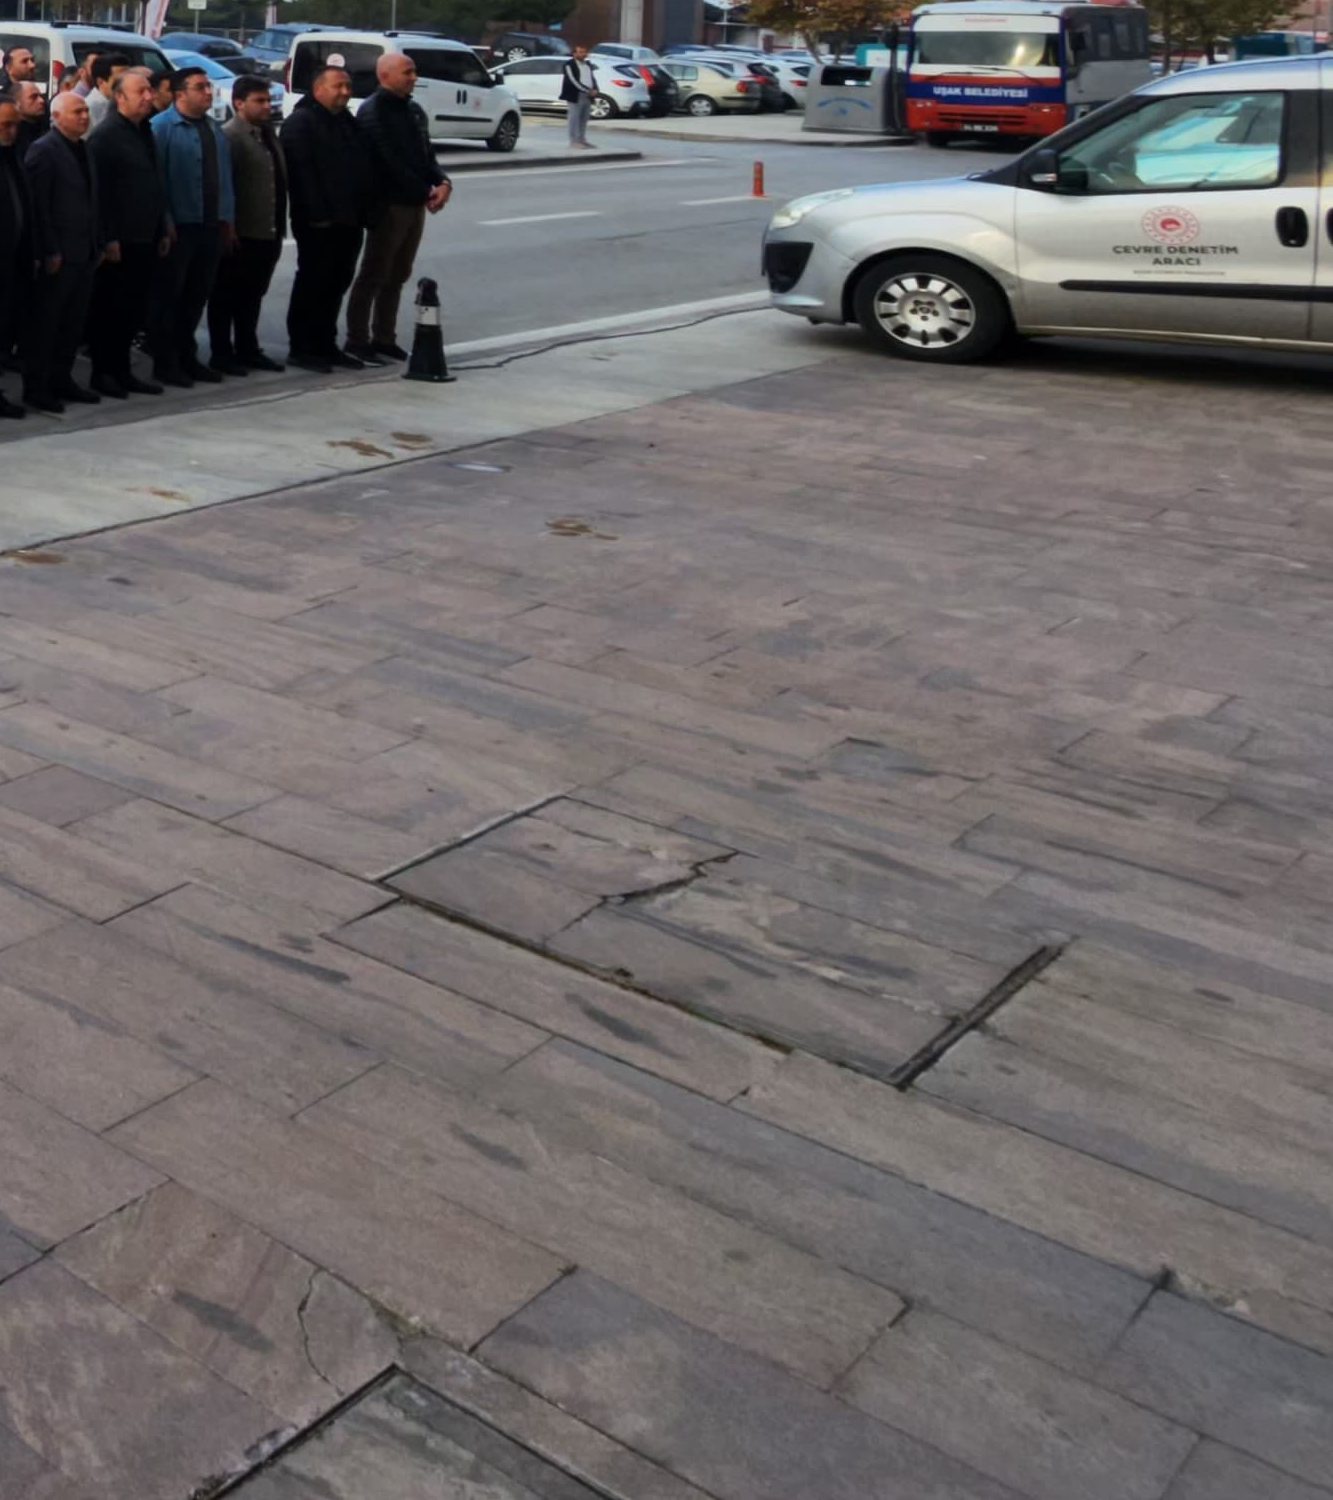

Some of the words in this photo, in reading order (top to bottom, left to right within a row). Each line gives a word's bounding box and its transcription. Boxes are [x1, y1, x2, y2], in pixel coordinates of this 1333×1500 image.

[933, 86, 962, 97] UŞAK
[964, 86, 1028, 98] BELEDİYESİ
[1167, 244, 1239, 254] DENETİM
[1152, 257, 1201, 266] ARACI
